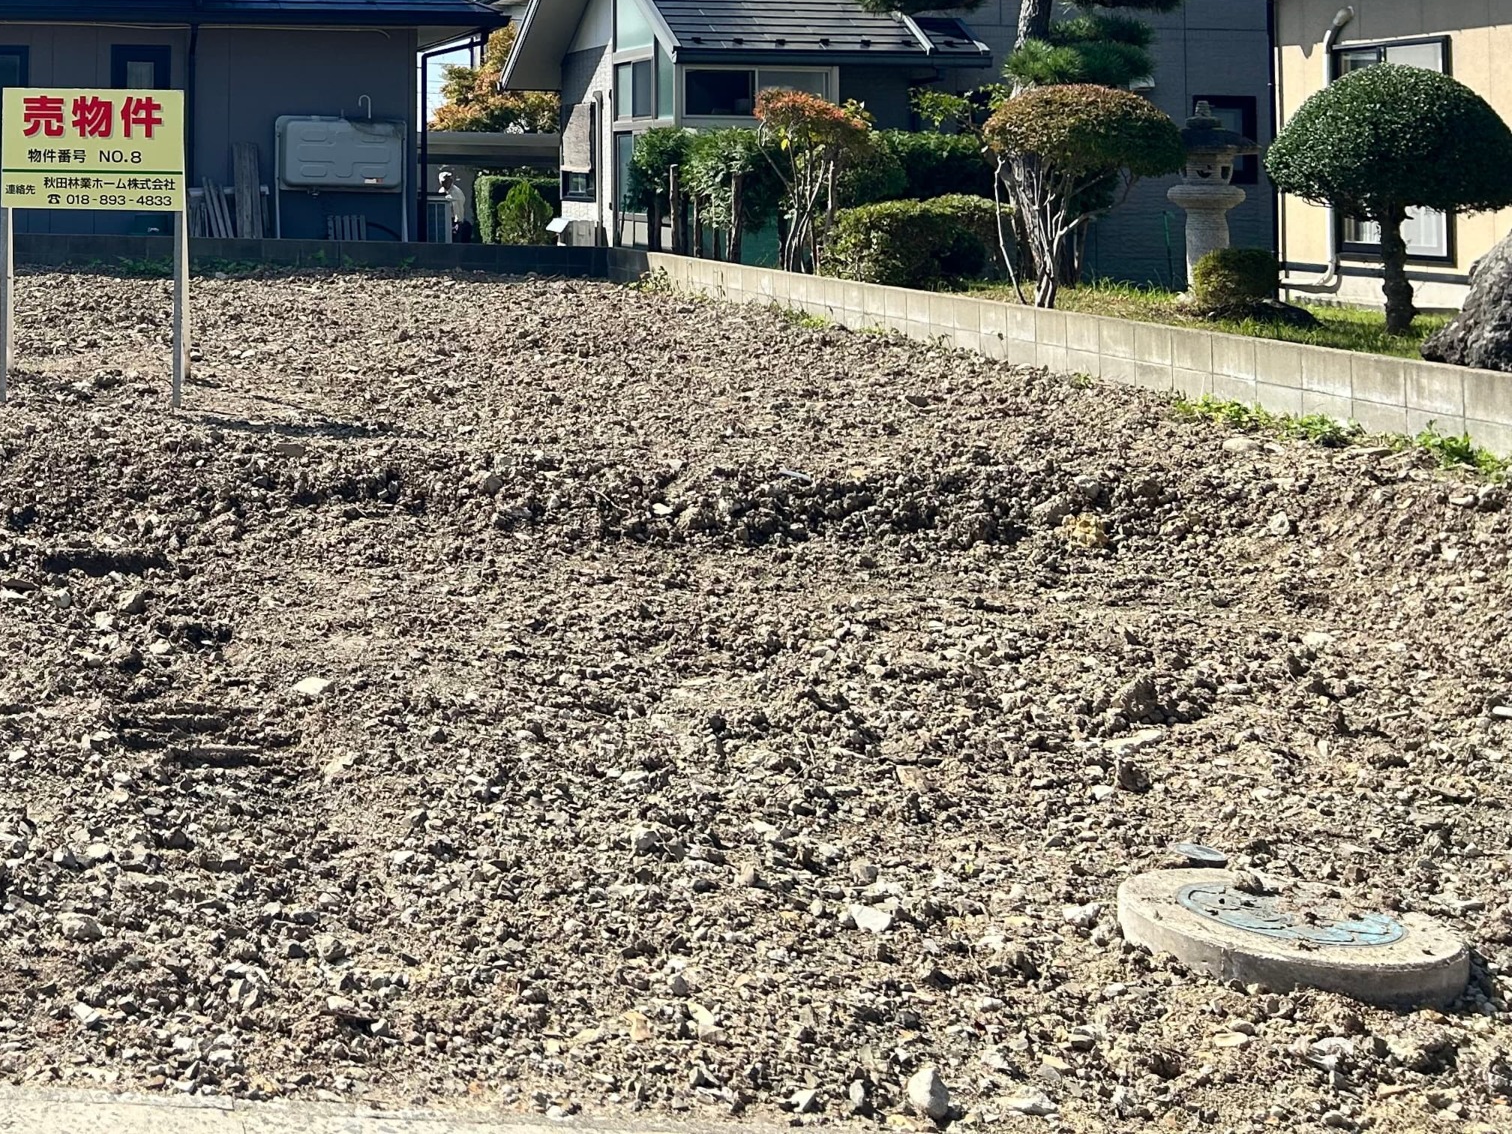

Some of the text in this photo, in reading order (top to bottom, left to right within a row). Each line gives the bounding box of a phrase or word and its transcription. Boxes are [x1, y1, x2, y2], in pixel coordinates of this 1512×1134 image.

[23, 95, 163, 139] 売物件
[27, 148, 142, 164] 物件番号 NO.8
[5, 184, 36, 195] 連絡先
[43, 176, 176, 192] 秋田林業ホーム株式会社
